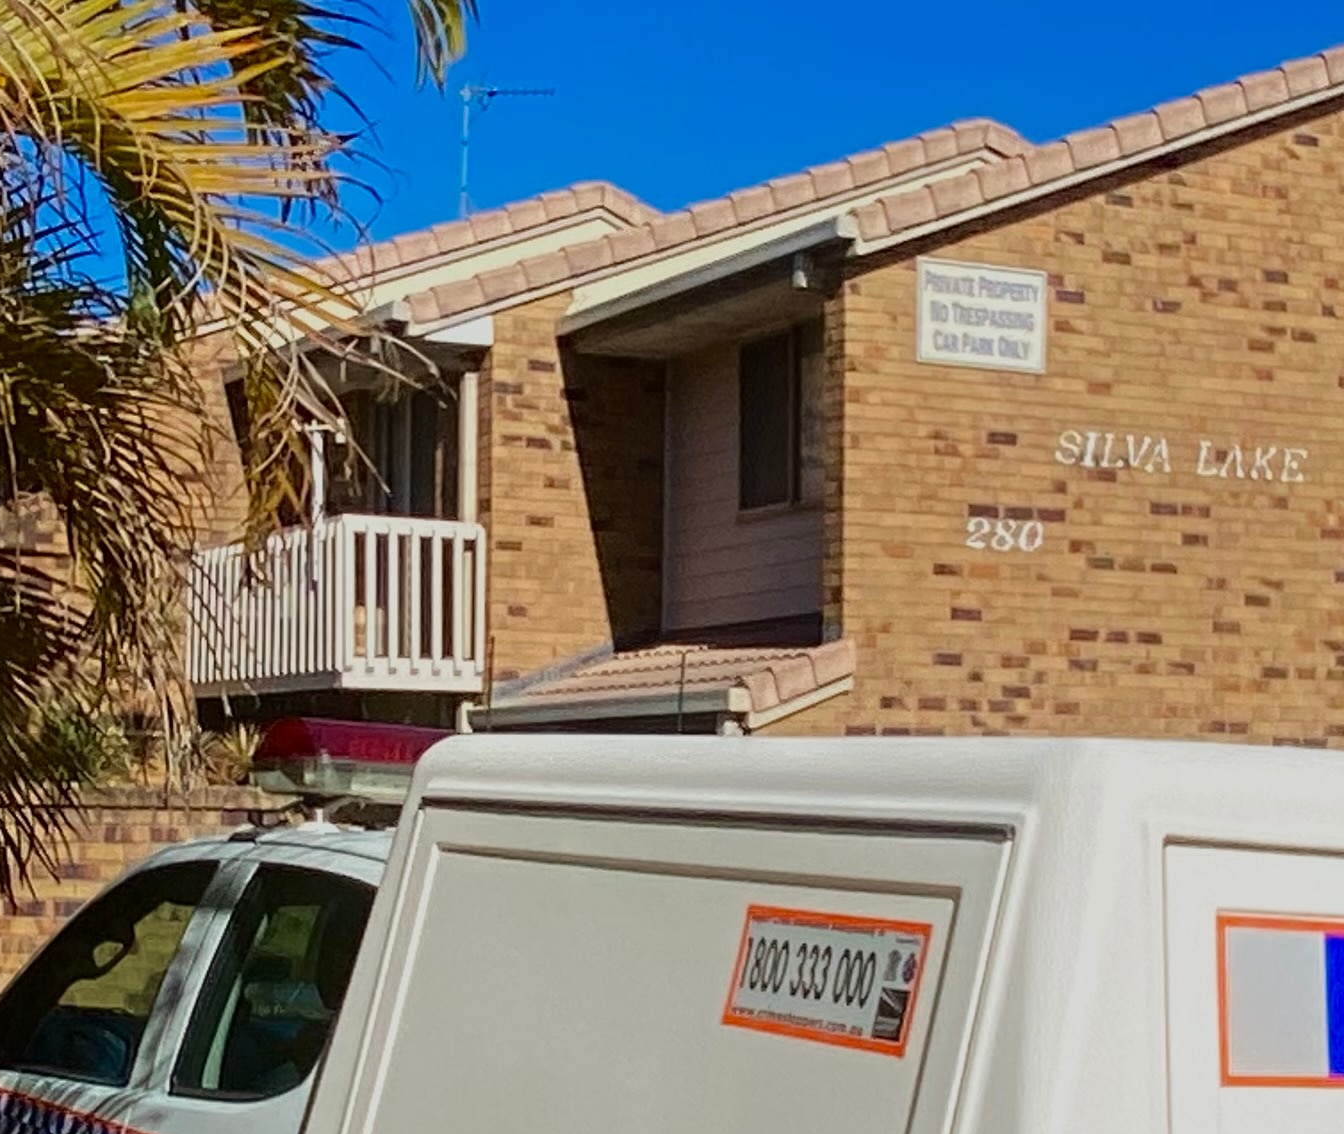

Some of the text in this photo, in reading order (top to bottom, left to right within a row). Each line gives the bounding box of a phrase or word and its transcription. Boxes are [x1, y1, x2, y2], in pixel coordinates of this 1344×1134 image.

[978, 276, 1039, 302] PROPERTY
[930, 300, 1034, 331] NO TRESPASSING
[933, 330, 1030, 360] CAR PARK ONLY
[1056, 430, 1308, 482] SILVA LAKE
[966, 517, 1044, 552] 280
[740, 936, 876, 1009] 1800 333 000
